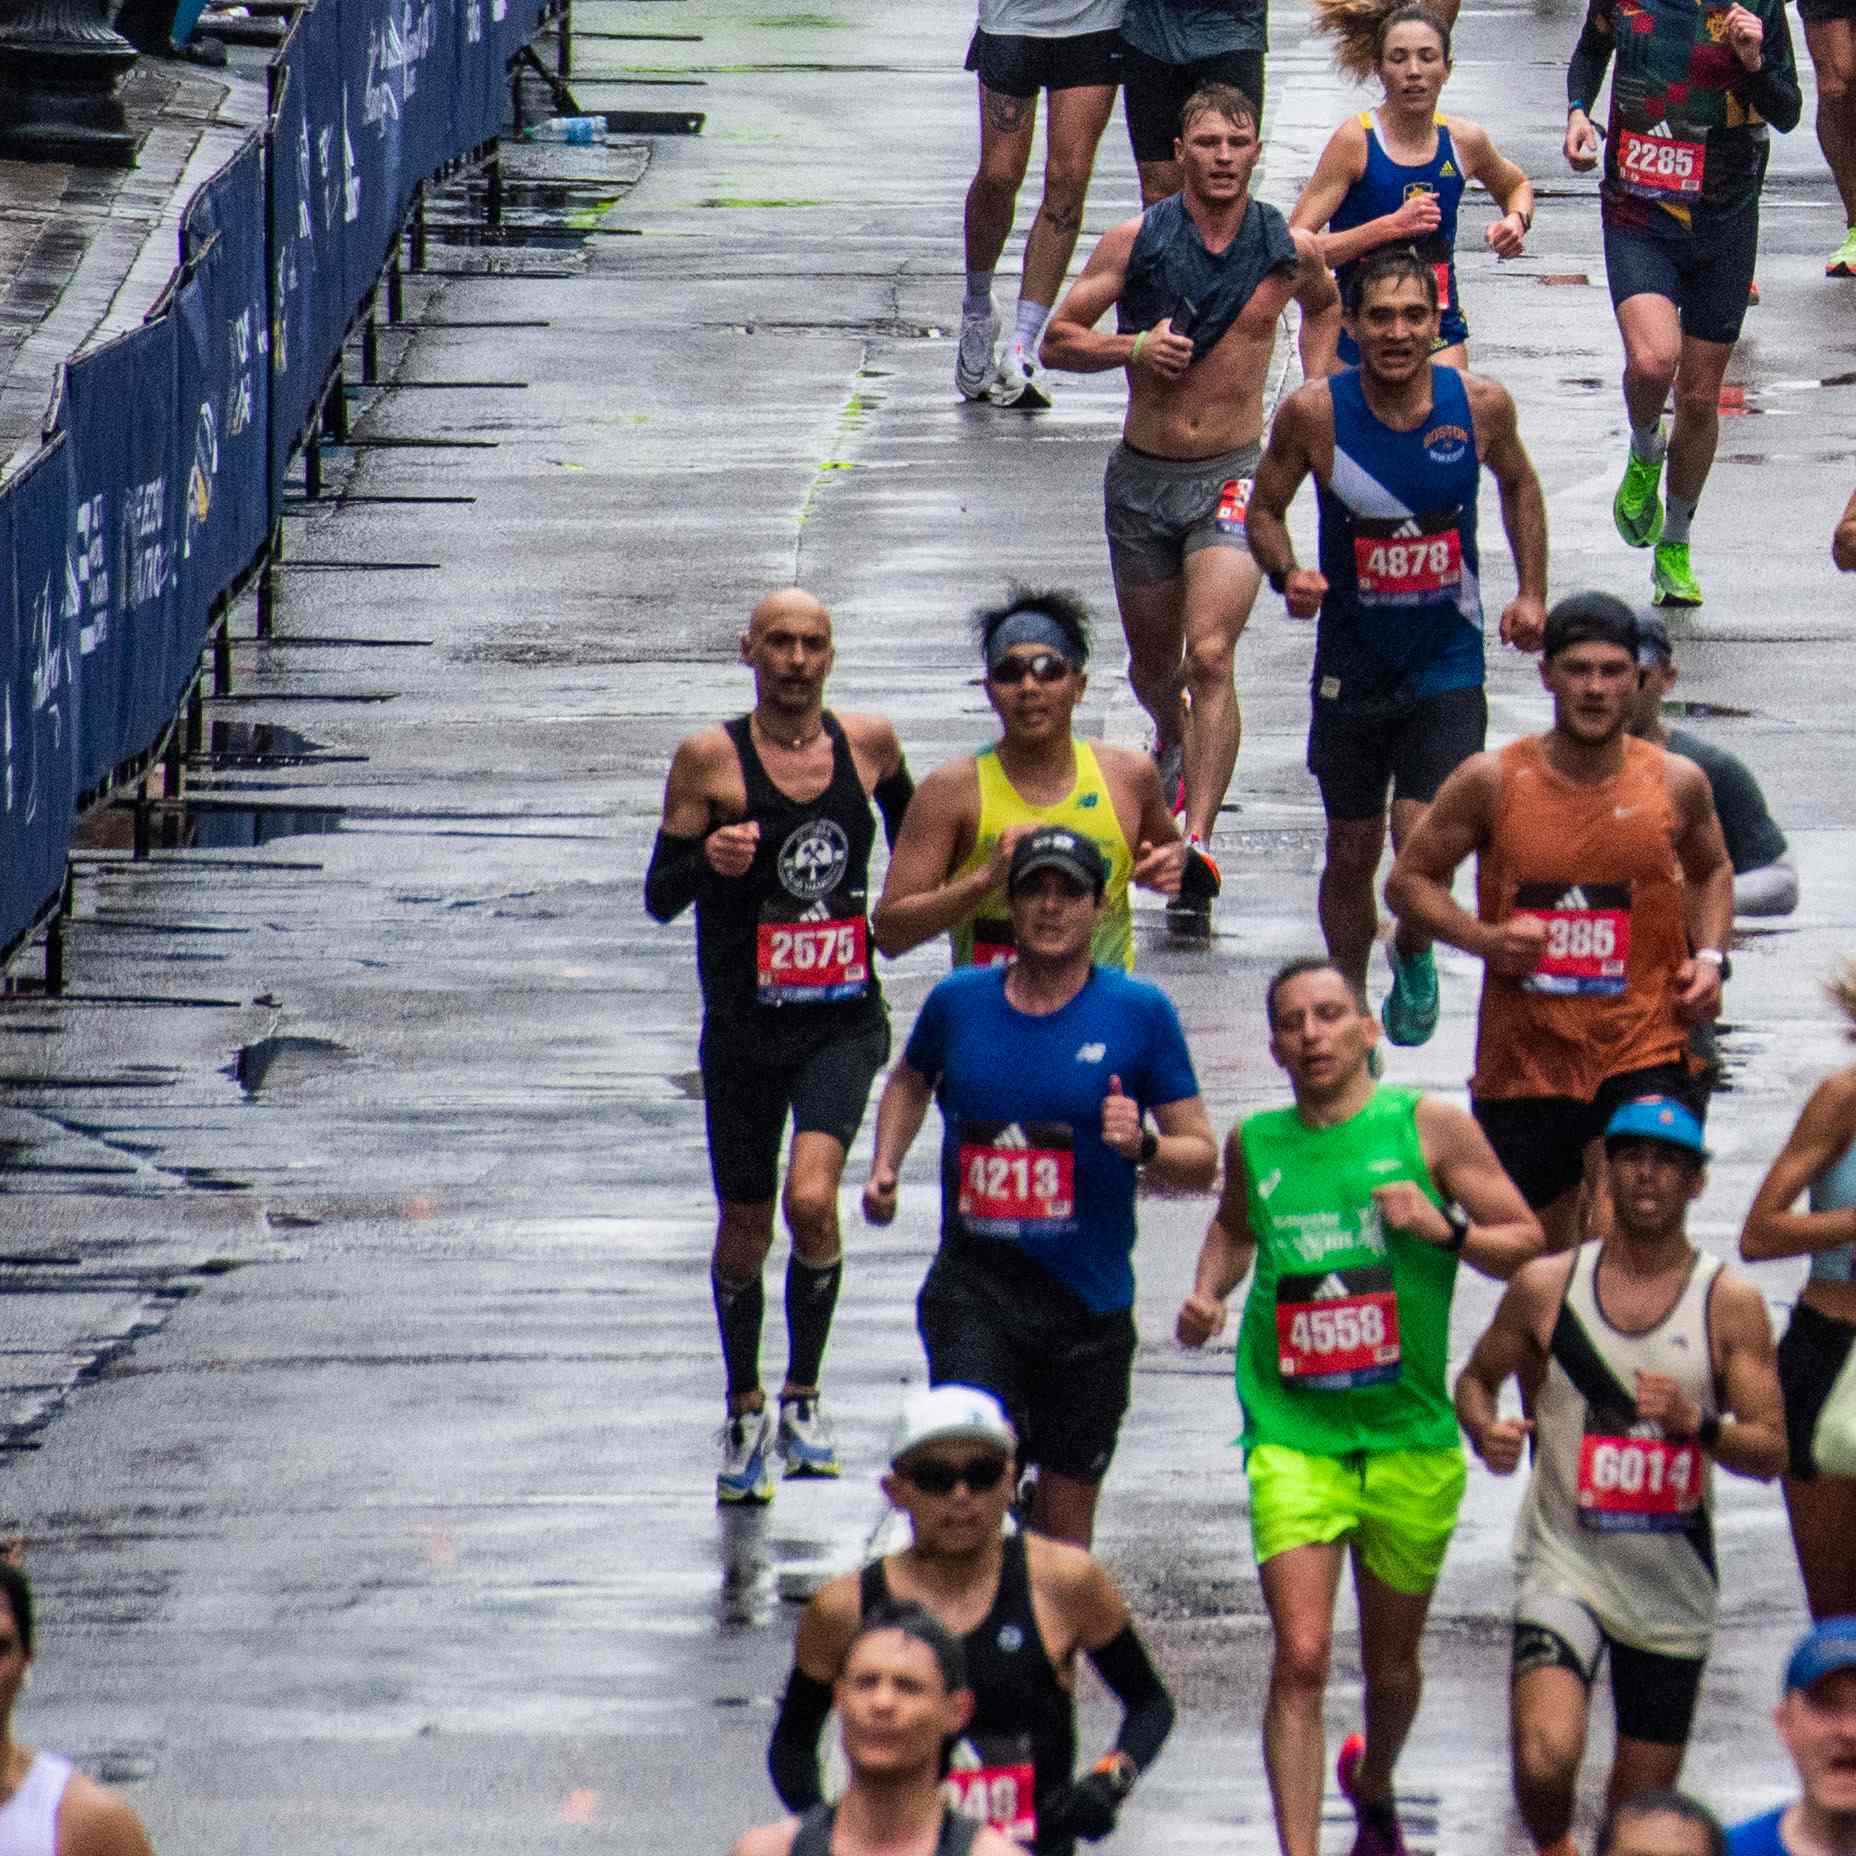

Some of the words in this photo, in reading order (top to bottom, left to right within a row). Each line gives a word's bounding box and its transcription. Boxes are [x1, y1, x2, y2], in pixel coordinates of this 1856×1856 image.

[1626, 143, 1694, 177] 2285
[1369, 540, 1449, 577] 4878
[770, 931, 855, 967] 2575
[1549, 920, 1614, 956] 385
[971, 1163, 1058, 1198] 4213
[1290, 1309, 1382, 1348] 4558
